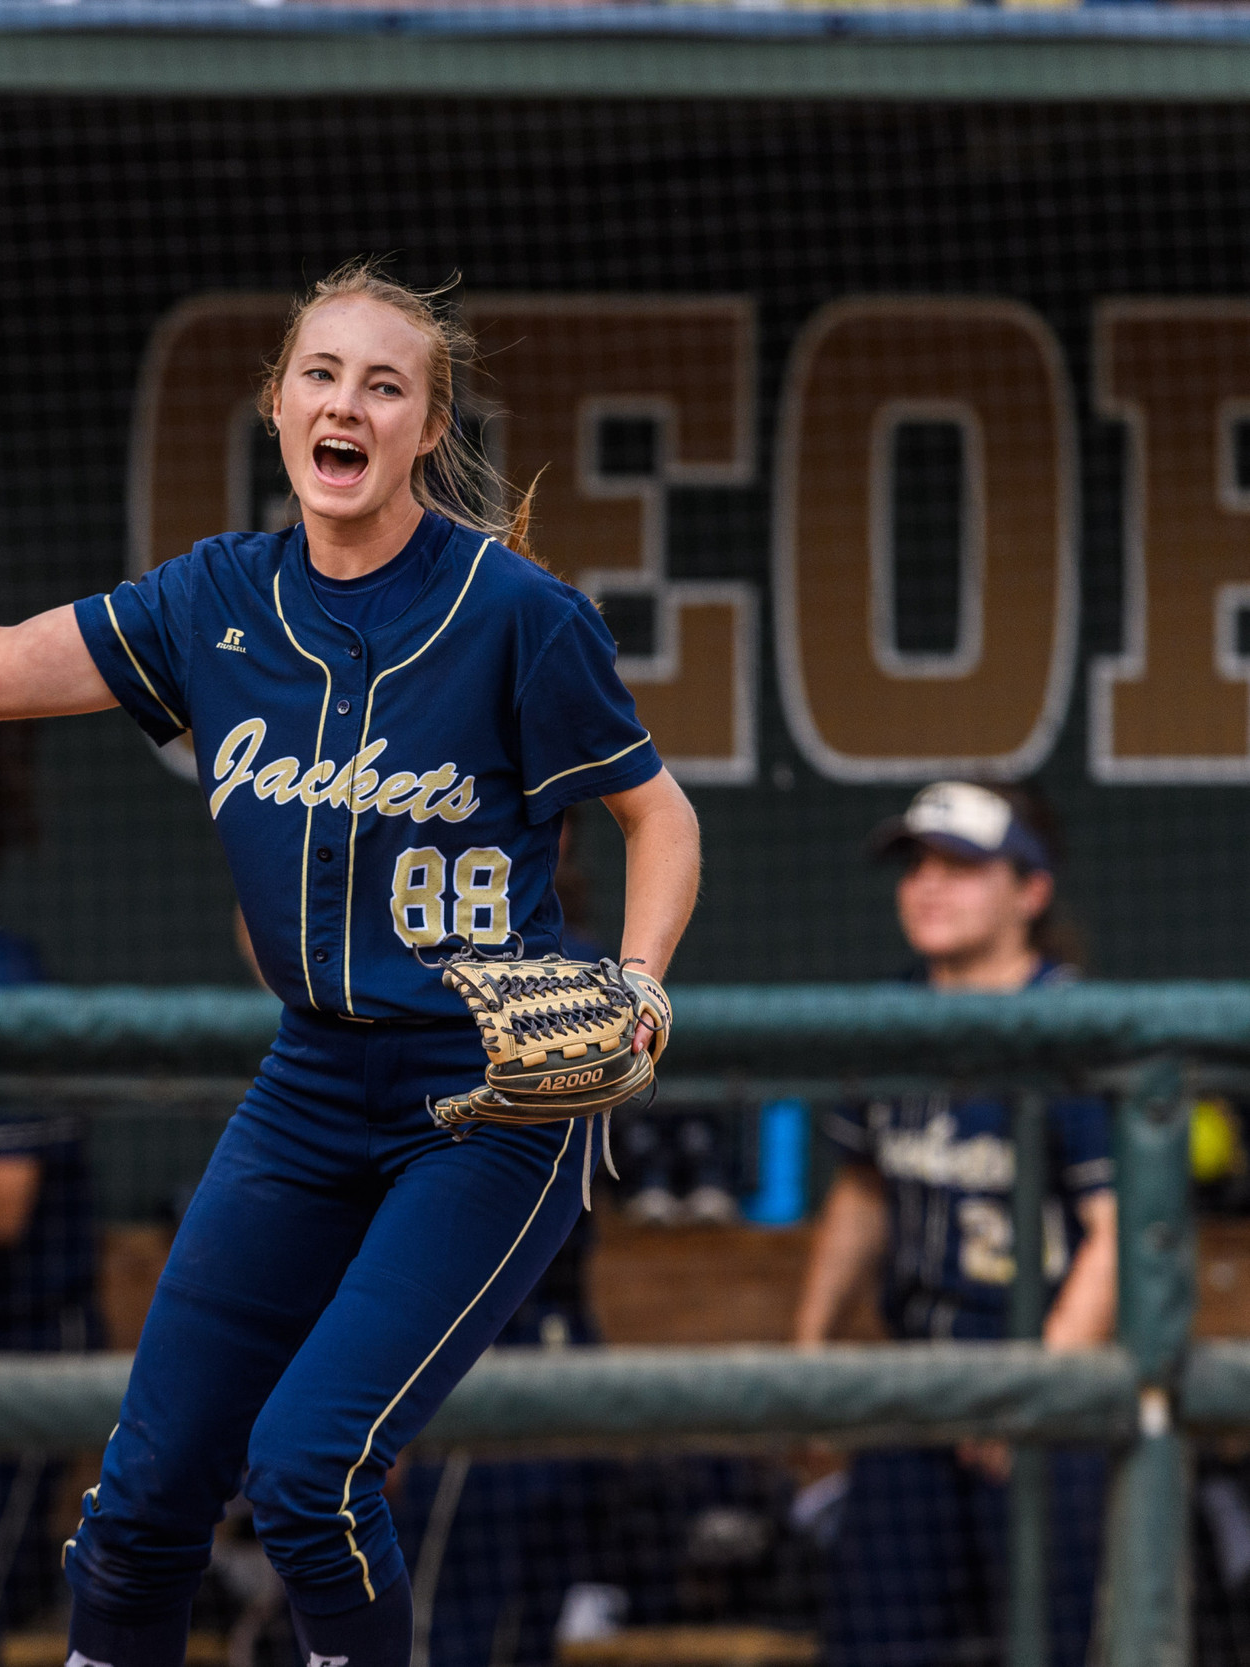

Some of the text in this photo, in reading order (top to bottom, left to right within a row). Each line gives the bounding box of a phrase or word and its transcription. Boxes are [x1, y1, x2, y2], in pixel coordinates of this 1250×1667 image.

[215, 641, 247, 654] RUSSELL
[209, 717, 480, 824] Jackets
[390, 845, 513, 948] 88
[535, 1067, 604, 1092] A2000
